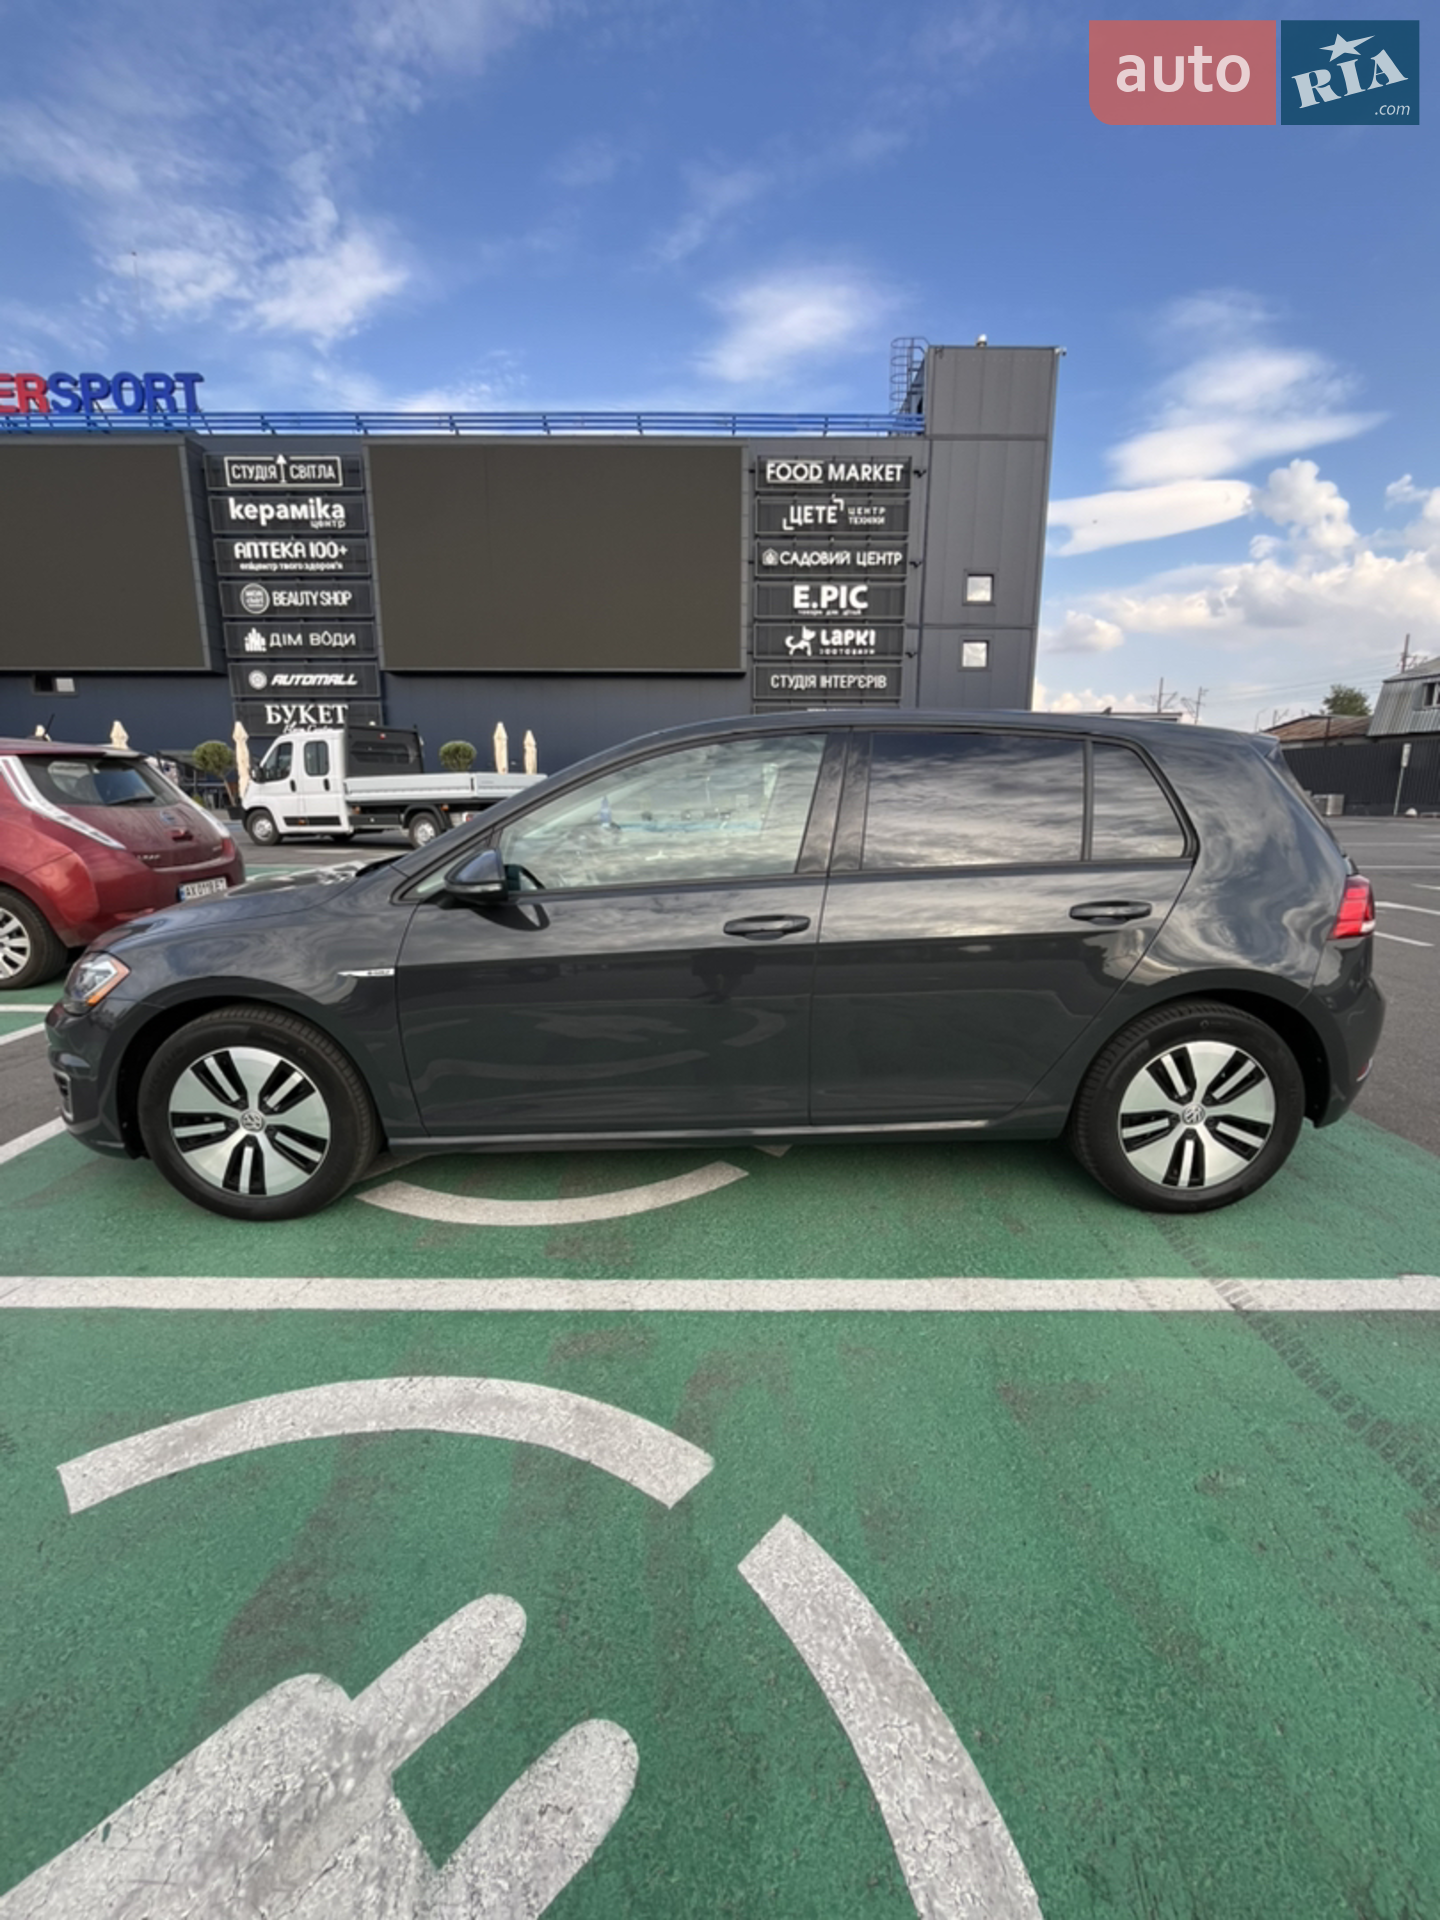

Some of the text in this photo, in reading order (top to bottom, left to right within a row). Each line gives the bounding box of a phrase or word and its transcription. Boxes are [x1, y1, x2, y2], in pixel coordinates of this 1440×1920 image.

[231, 464, 336, 481] СТУДІЯ СВІТЛА
[766, 463, 904, 482] FOOD MARKET
[233, 541, 348, 559] АПТЕКА 100+
[779, 550, 903, 567] САДОВИЙ ЦЕНТР
[272, 590, 318, 607] BEAUTY
[320, 590, 352, 606] SHOP
[793, 584, 869, 609] E.PIC
[269, 631, 356, 647] ДІМ ВОДИ
[271, 673, 358, 686] AUTOMALL
[771, 674, 817, 690] СТУДІЯ
[265, 704, 348, 725] БУКЕТ
